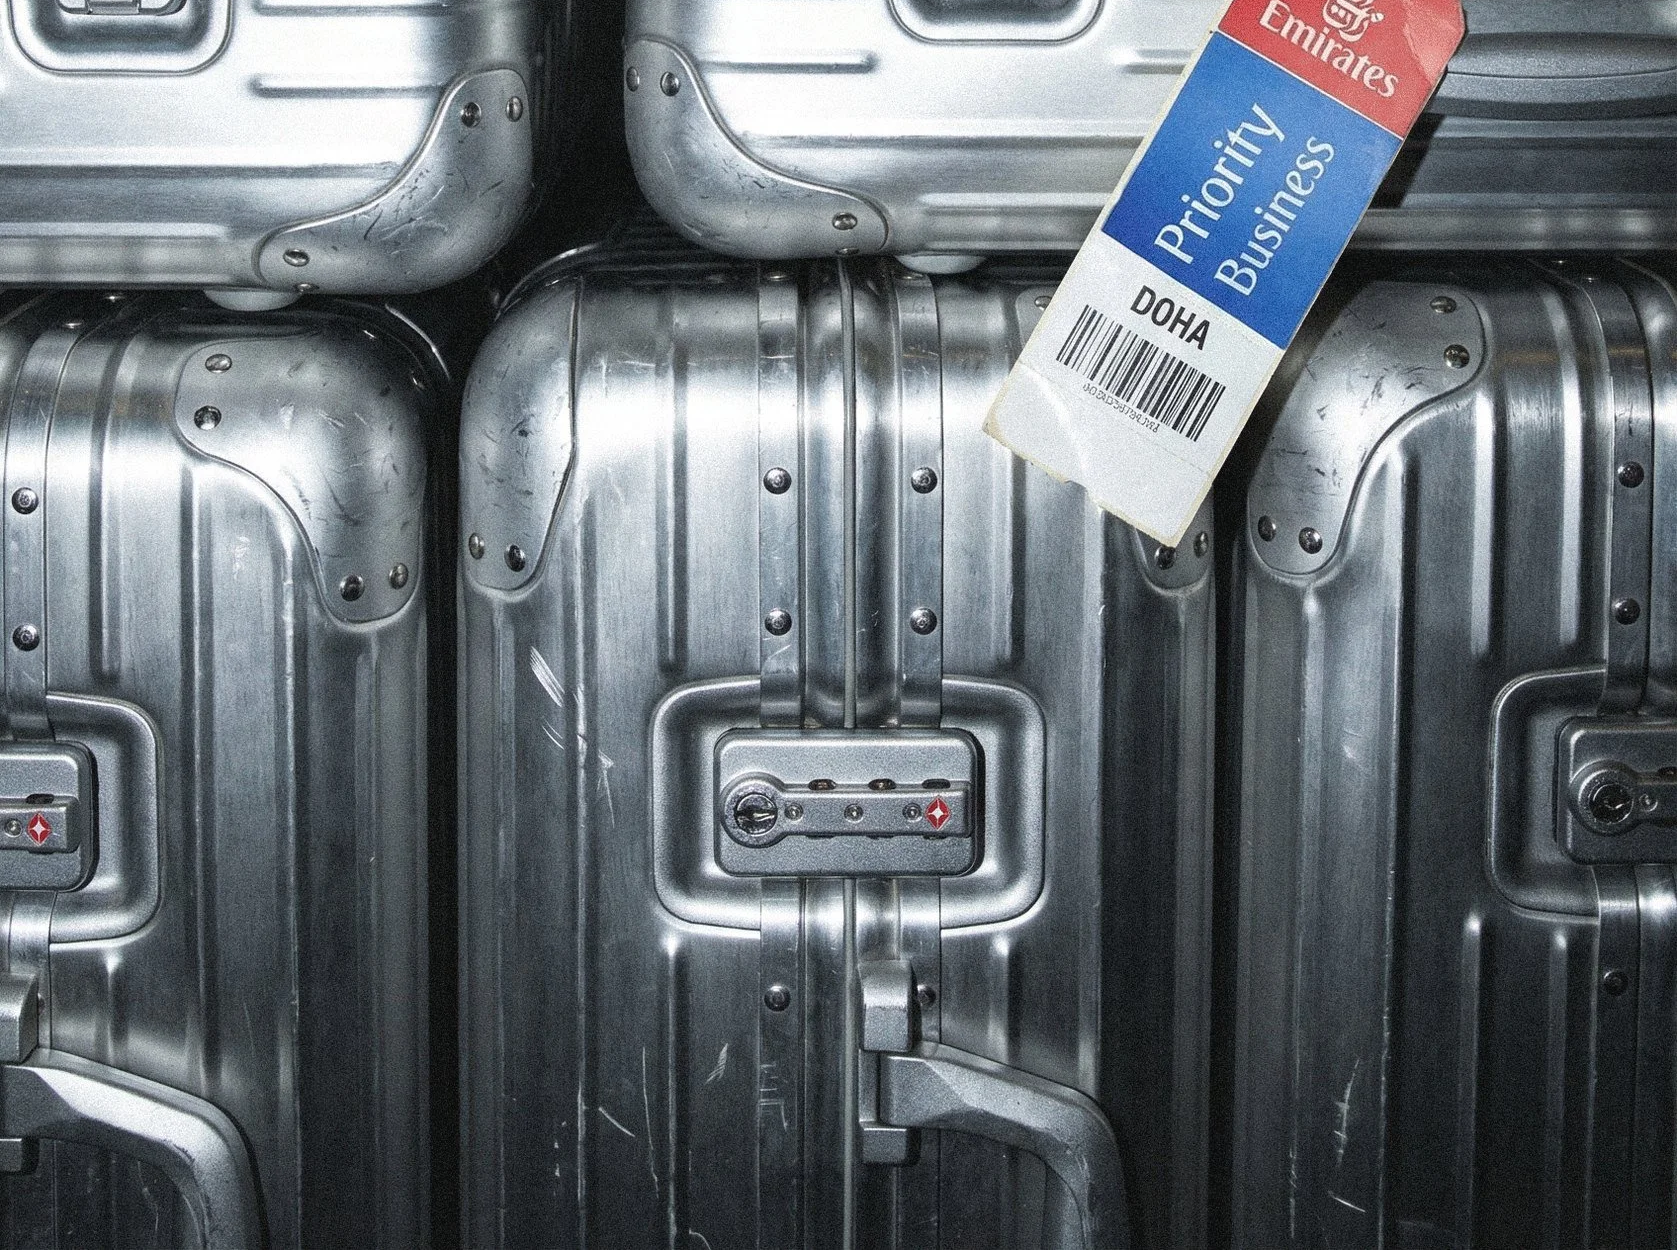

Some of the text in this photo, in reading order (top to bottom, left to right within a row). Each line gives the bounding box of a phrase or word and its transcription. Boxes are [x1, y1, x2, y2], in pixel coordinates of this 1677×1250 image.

[1153, 102, 1286, 266] Priority
[1213, 135, 1336, 297] Business
[1129, 284, 1211, 351] DOHA
